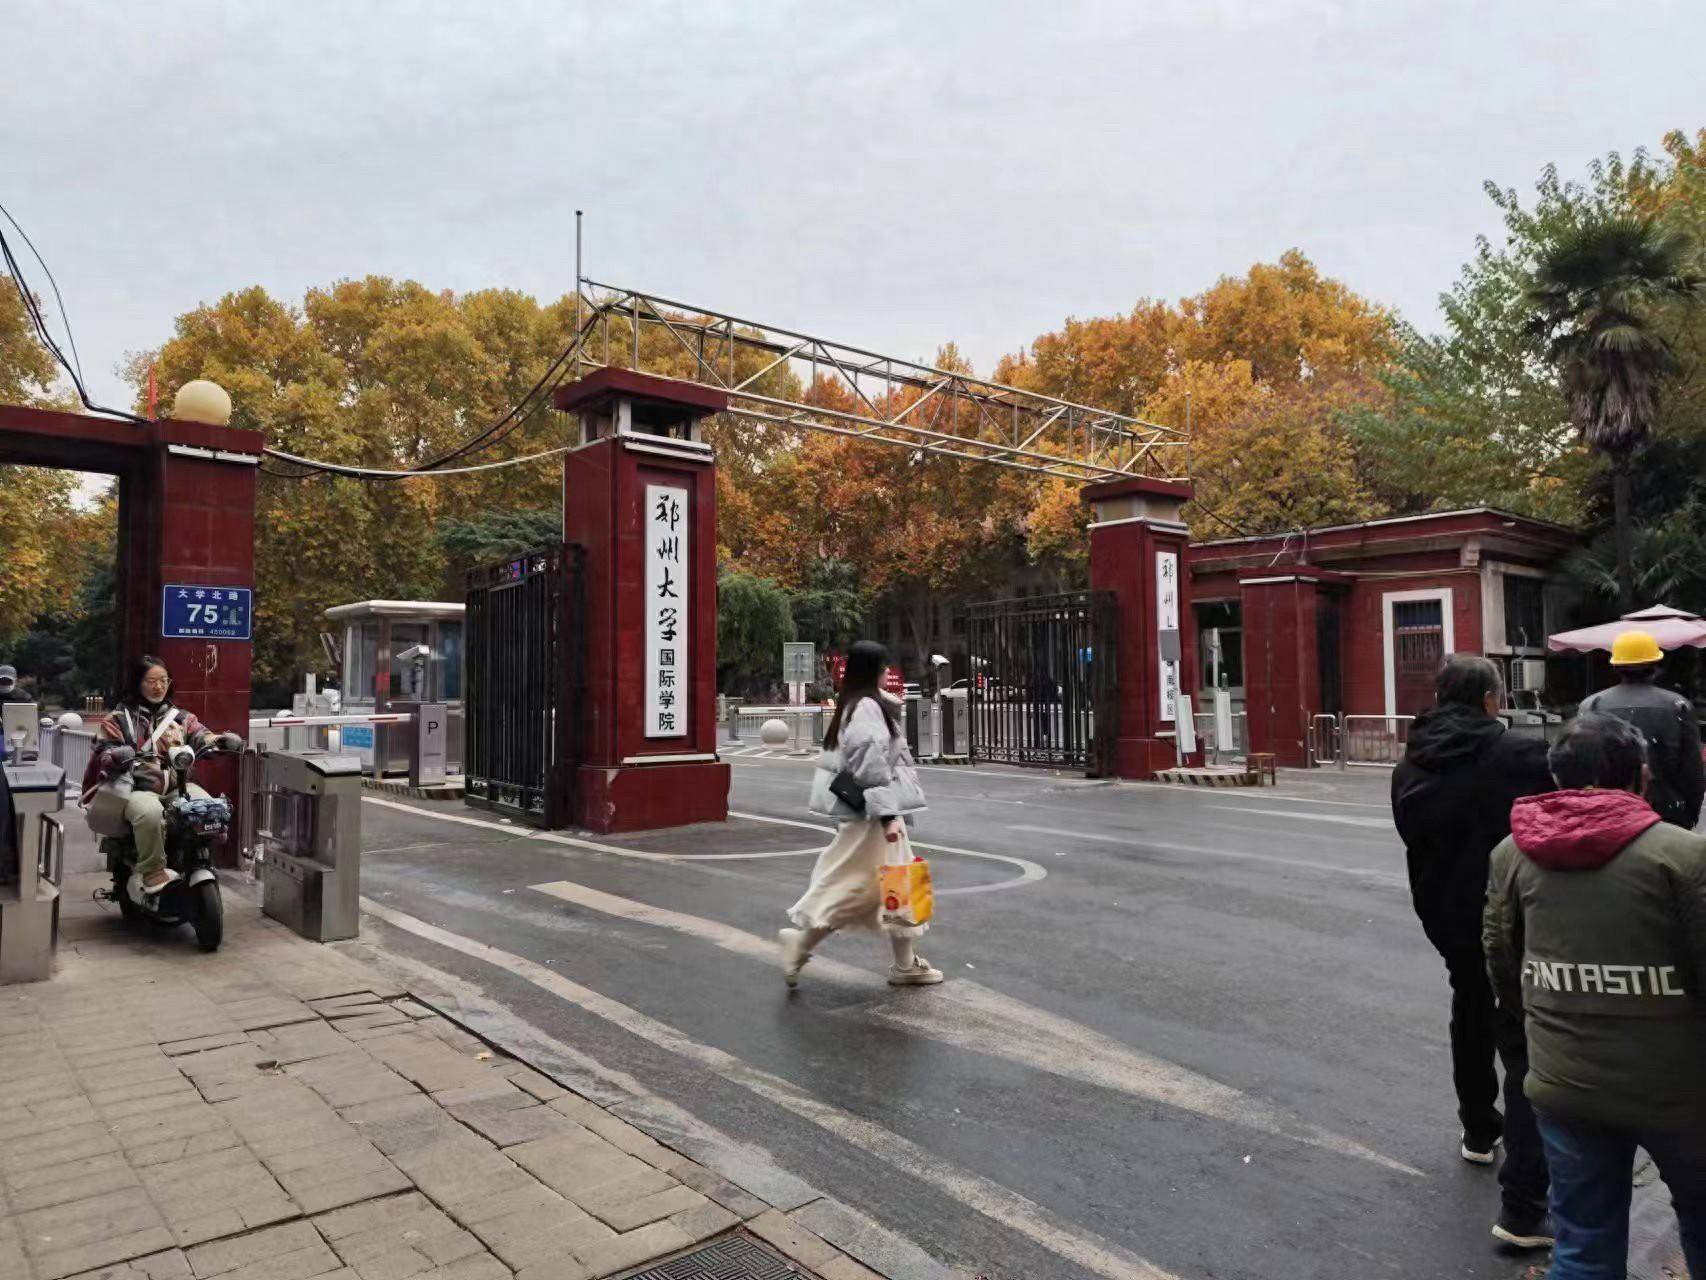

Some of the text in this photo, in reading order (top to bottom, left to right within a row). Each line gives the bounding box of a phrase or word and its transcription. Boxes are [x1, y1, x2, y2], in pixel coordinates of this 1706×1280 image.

[187, 604, 218, 624] 75
[655, 495, 679, 730] 郑州大学国际学院
[428, 721, 439, 735] P
